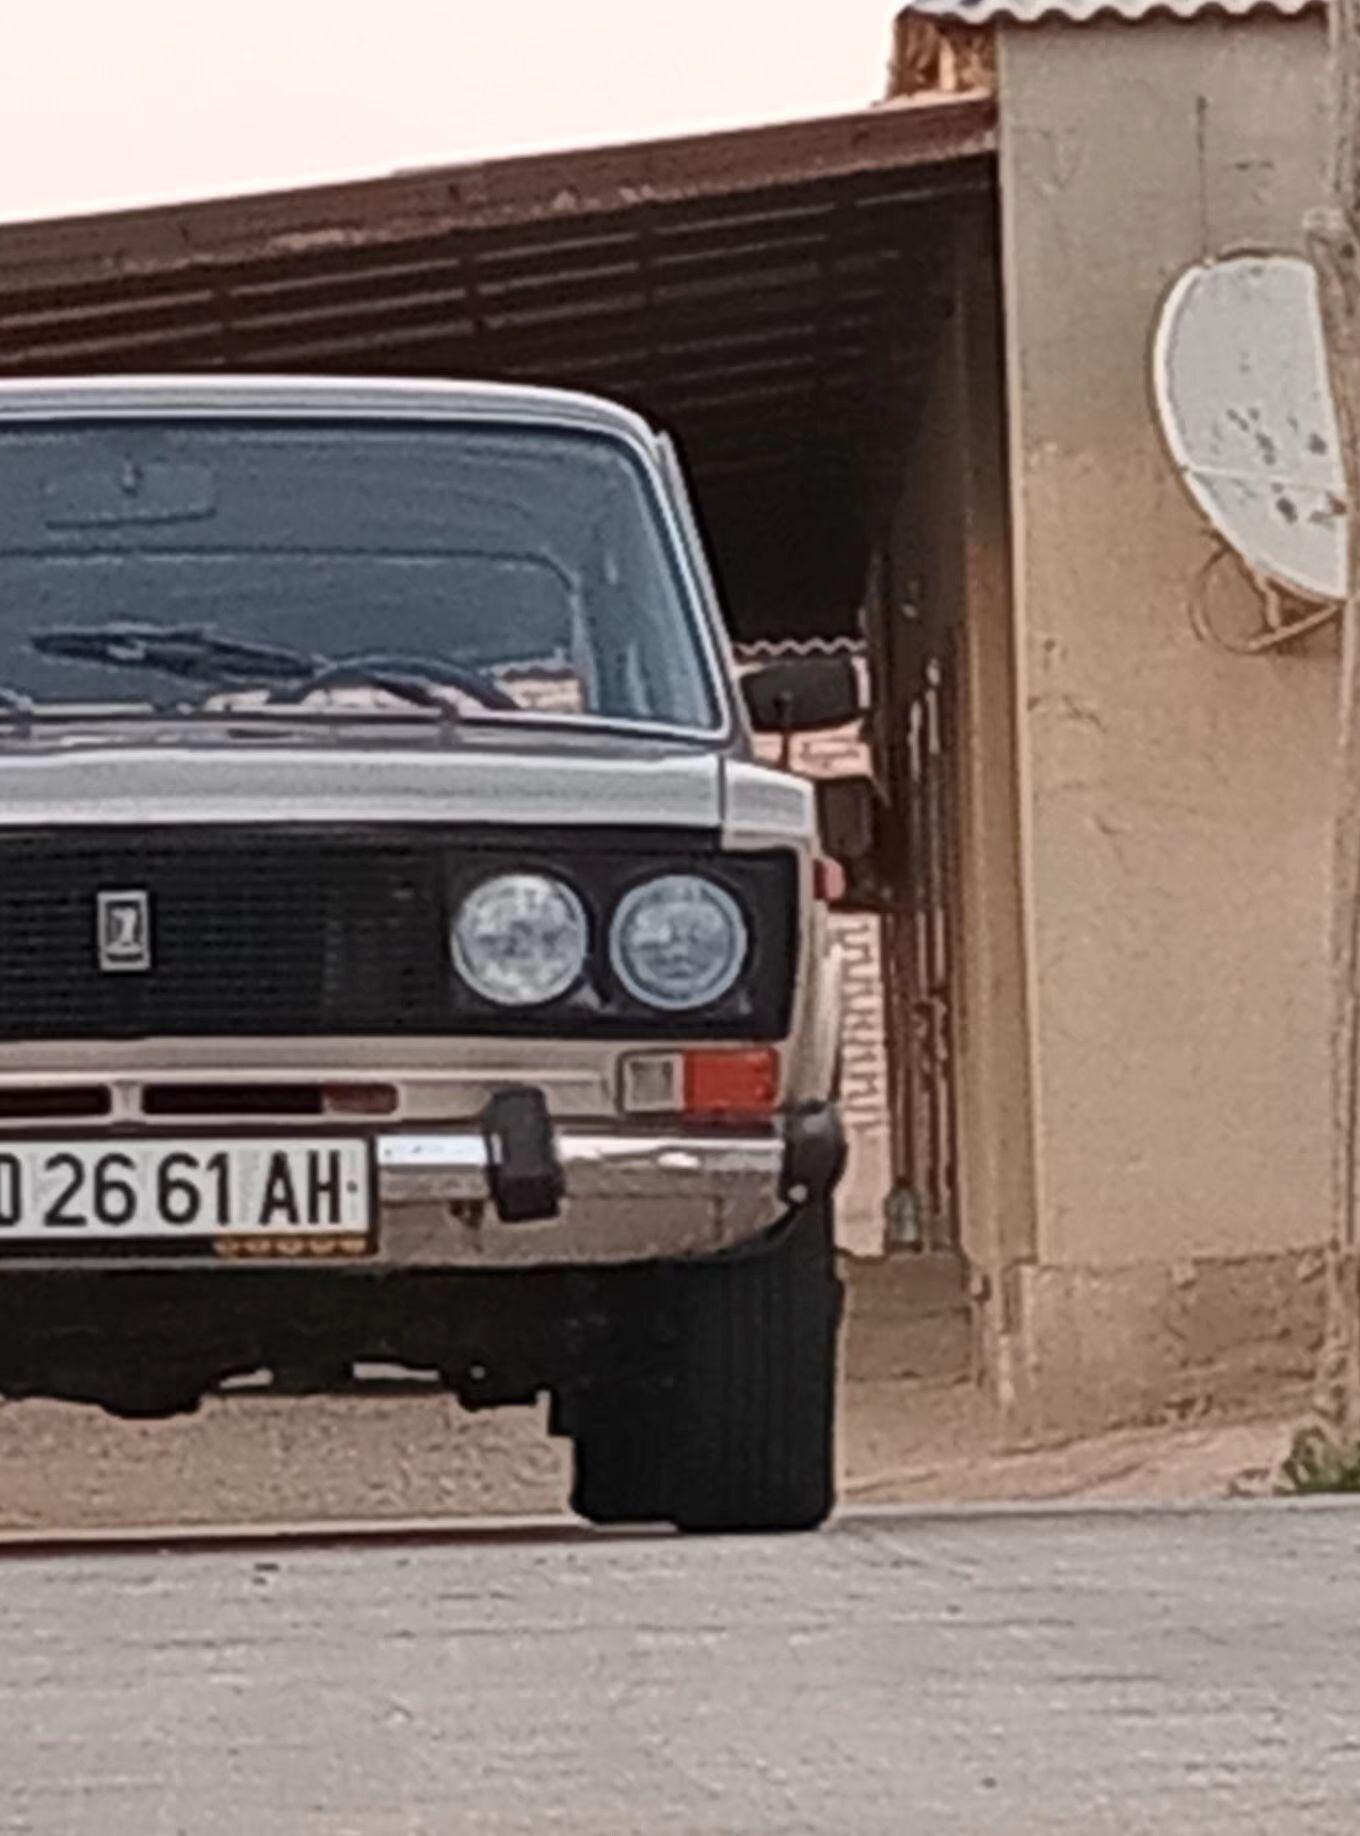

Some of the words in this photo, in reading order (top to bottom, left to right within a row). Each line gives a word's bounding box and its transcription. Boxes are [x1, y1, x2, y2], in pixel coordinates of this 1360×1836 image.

[44, 1152, 137, 1227] 26
[156, 1152, 230, 1227] 61
[258, 1150, 340, 1226] AH
